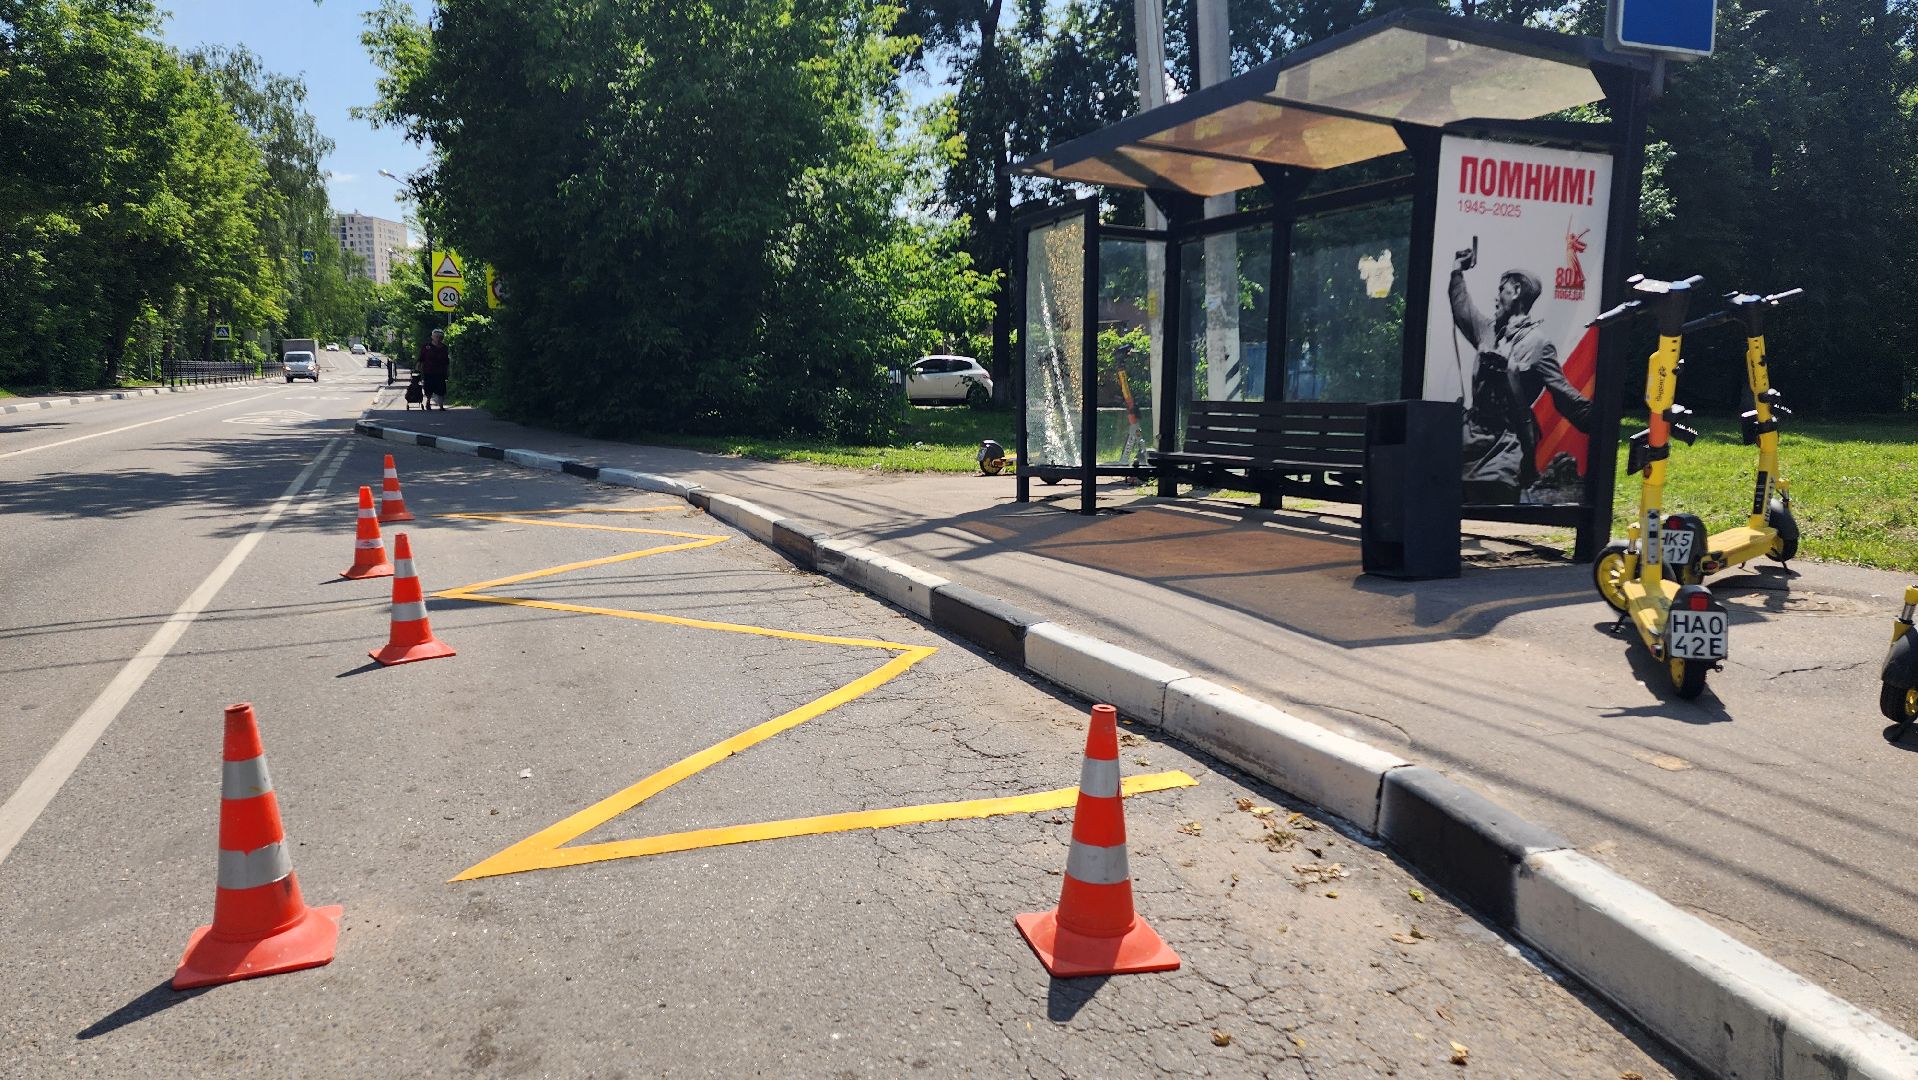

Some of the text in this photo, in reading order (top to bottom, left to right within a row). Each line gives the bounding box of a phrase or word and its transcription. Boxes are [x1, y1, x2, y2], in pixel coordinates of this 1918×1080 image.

[1459, 156, 1596, 206] ПОМНИМ!
[1555, 267, 1575, 287] 80
[442, 292, 456, 302] 20
